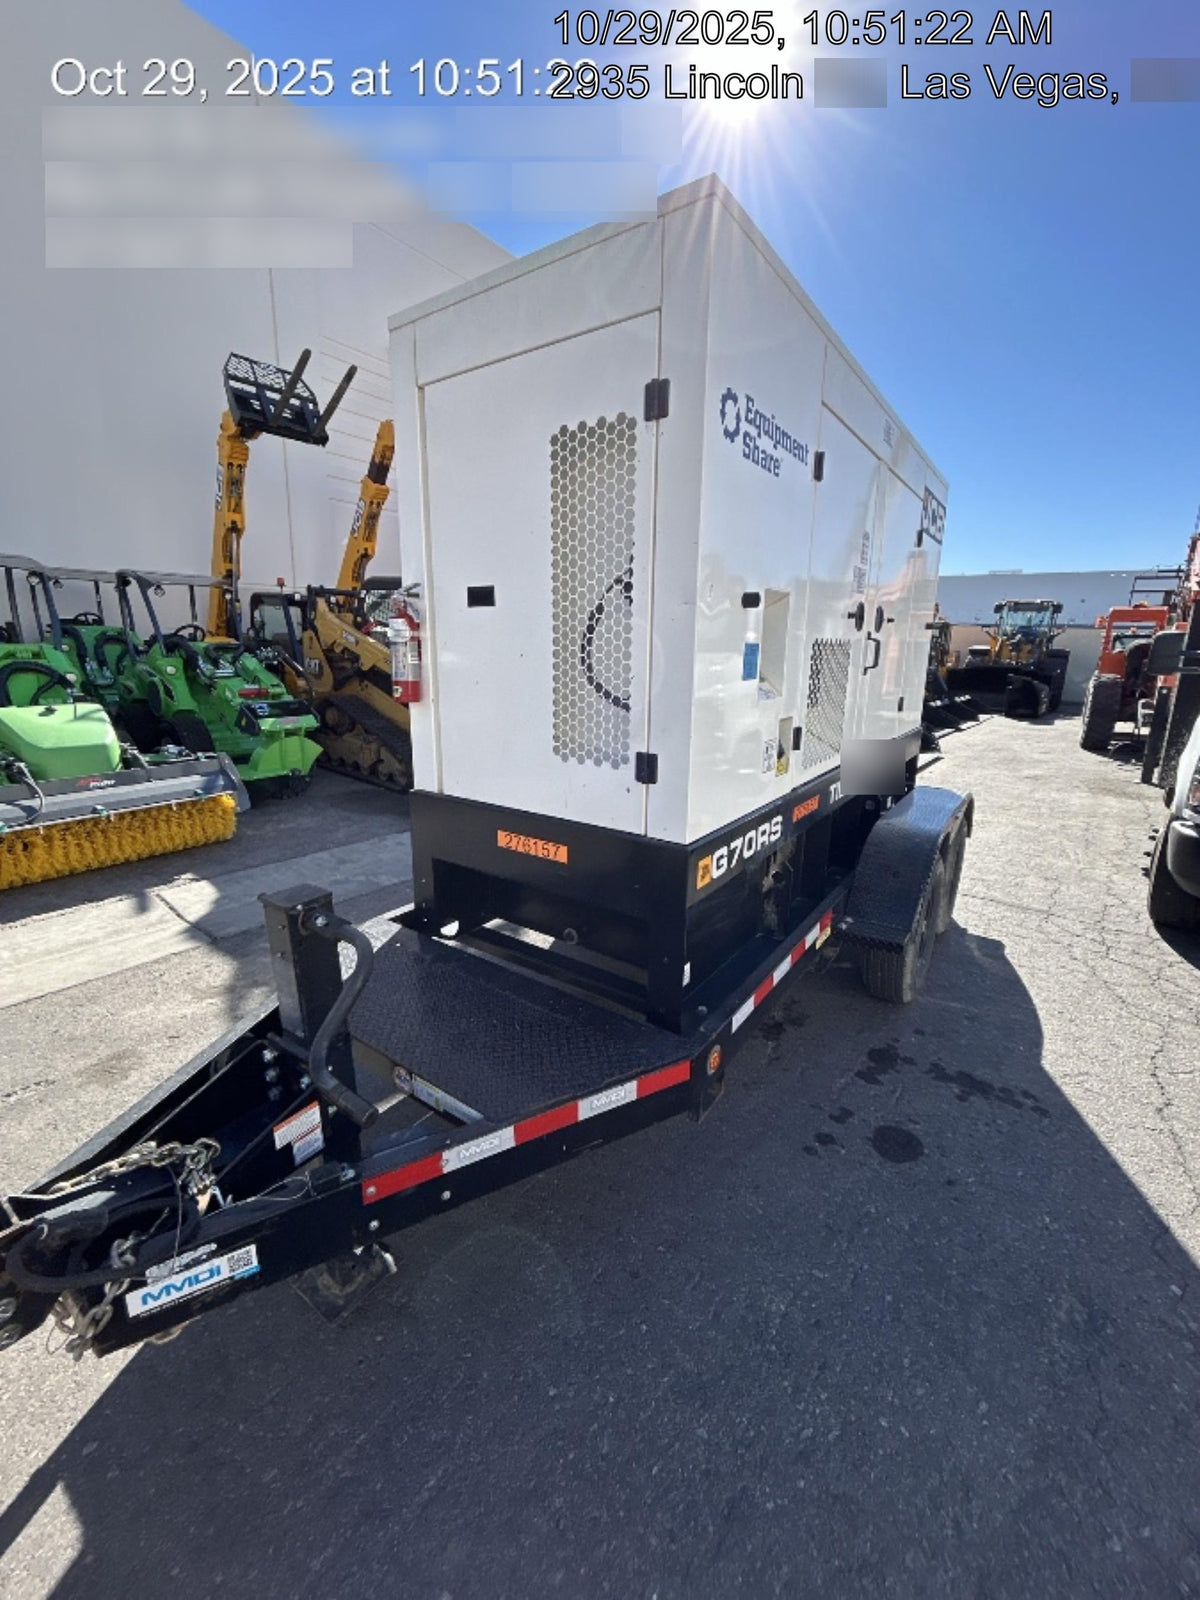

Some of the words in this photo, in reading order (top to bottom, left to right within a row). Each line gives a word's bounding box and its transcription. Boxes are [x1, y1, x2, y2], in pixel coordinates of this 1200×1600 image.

[743, 429, 780, 477] Share
[745, 393, 809, 466] Equipment
[712, 815, 783, 879] G70RS
[141, 1265, 222, 1306] MMDI
